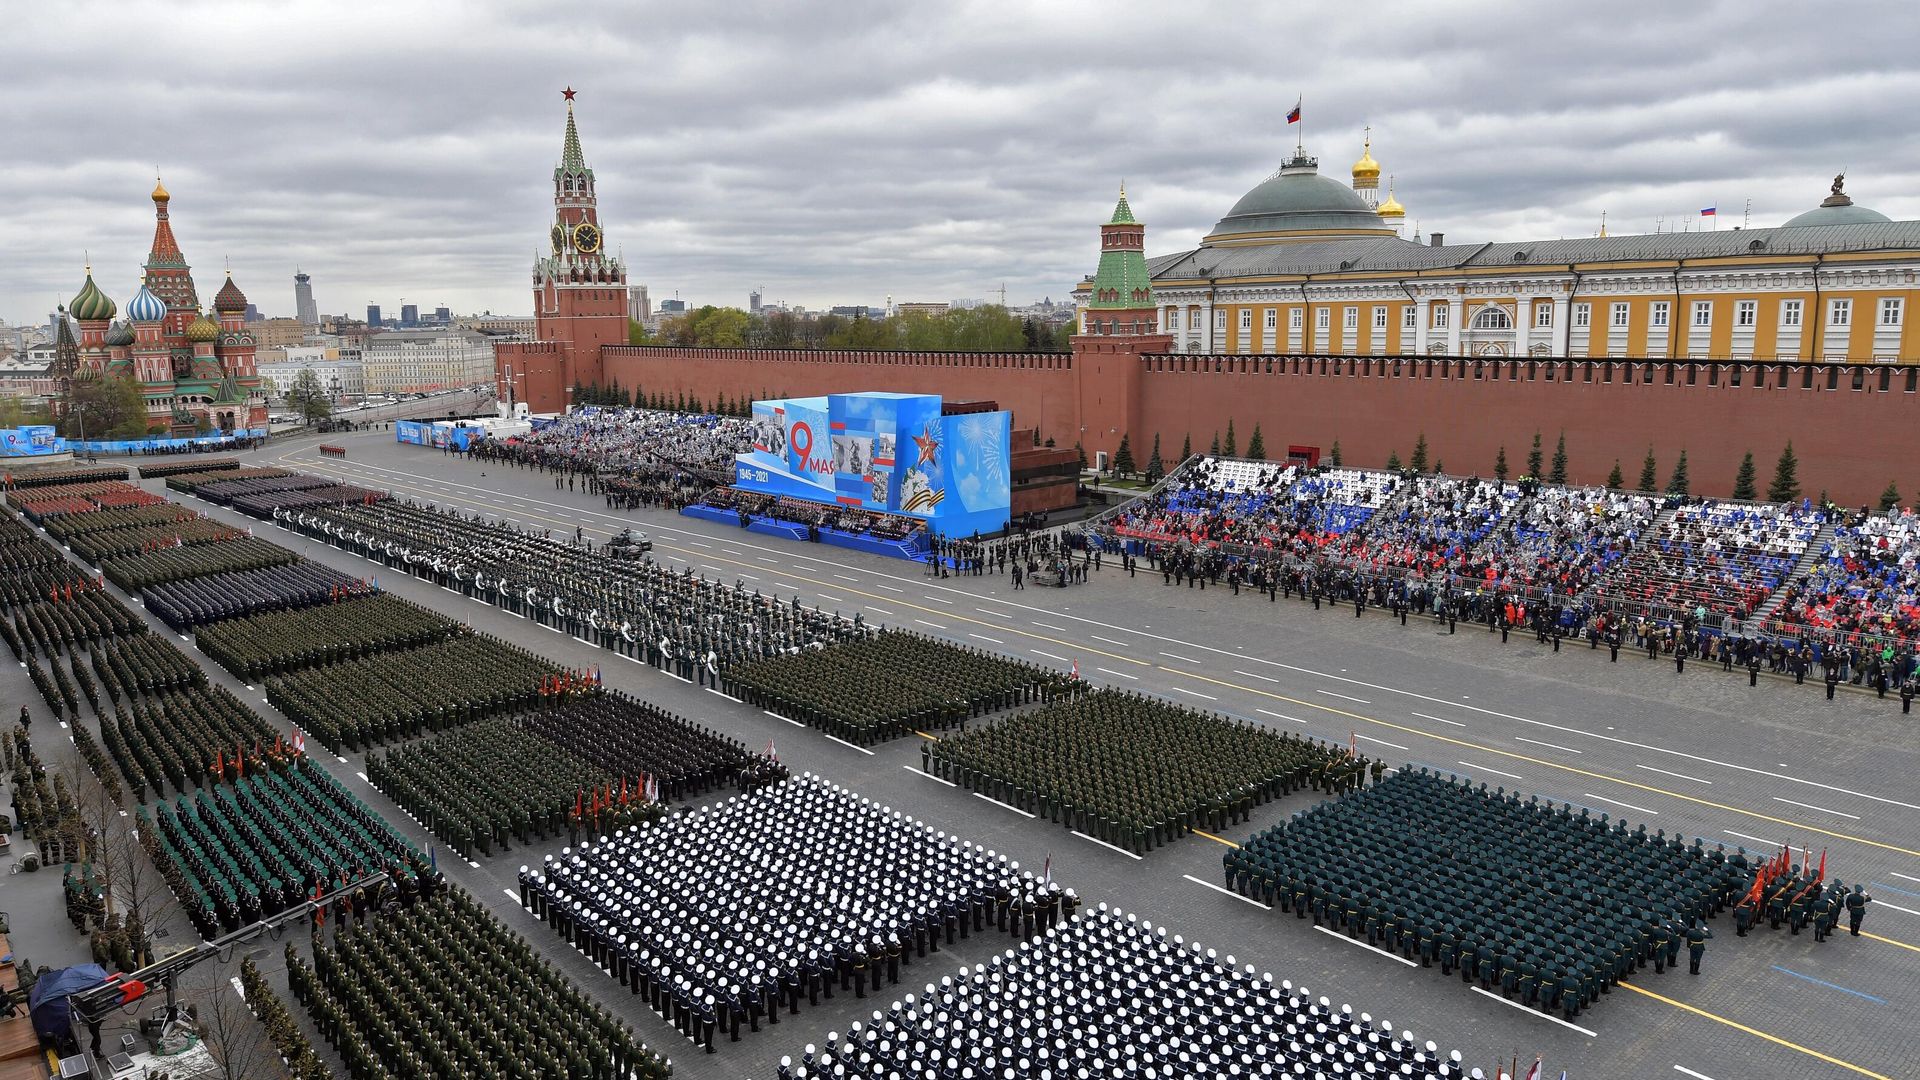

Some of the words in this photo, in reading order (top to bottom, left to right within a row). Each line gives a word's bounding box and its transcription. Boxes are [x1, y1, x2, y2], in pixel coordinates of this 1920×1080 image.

[8, 434, 16, 444] 9
[791, 421, 812, 470] 9
[810, 458, 834, 474] МАЯ
